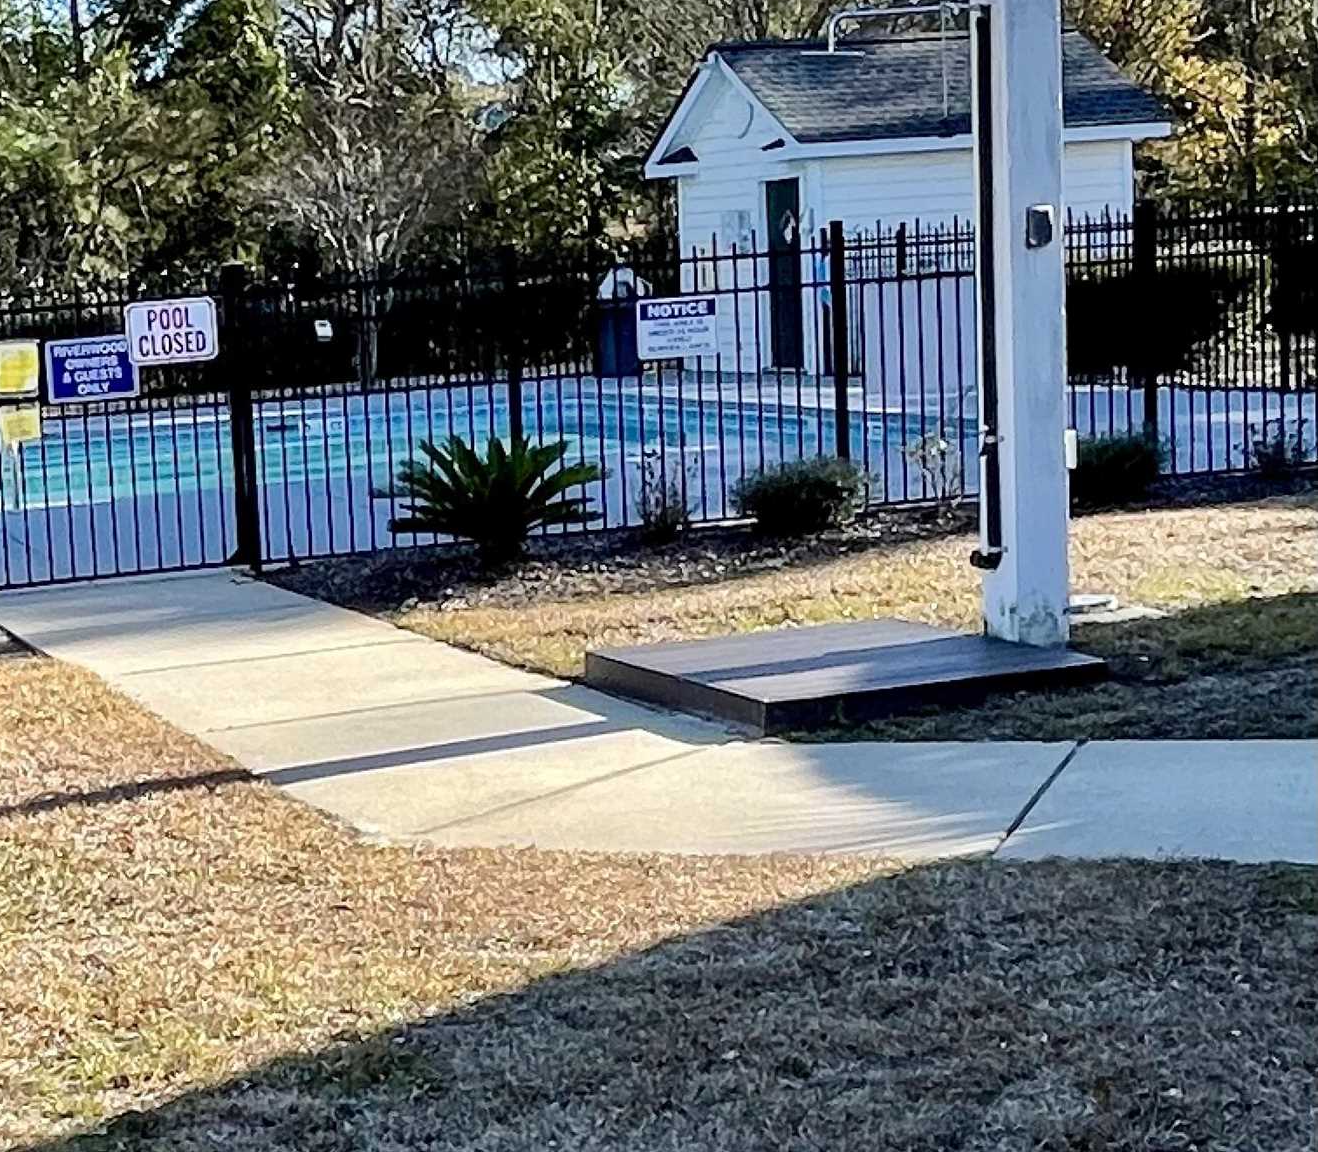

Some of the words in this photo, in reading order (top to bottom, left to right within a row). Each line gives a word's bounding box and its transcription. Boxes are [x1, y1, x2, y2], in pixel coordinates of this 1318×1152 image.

[648, 301, 708, 318] NOTICE
[147, 307, 194, 331] POOL
[139, 330, 206, 357] CLOSED
[65, 355, 119, 370] OWNERS
[62, 371, 72, 384] &
[74, 366, 122, 382] GUESTS
[77, 381, 110, 395] ONLY
